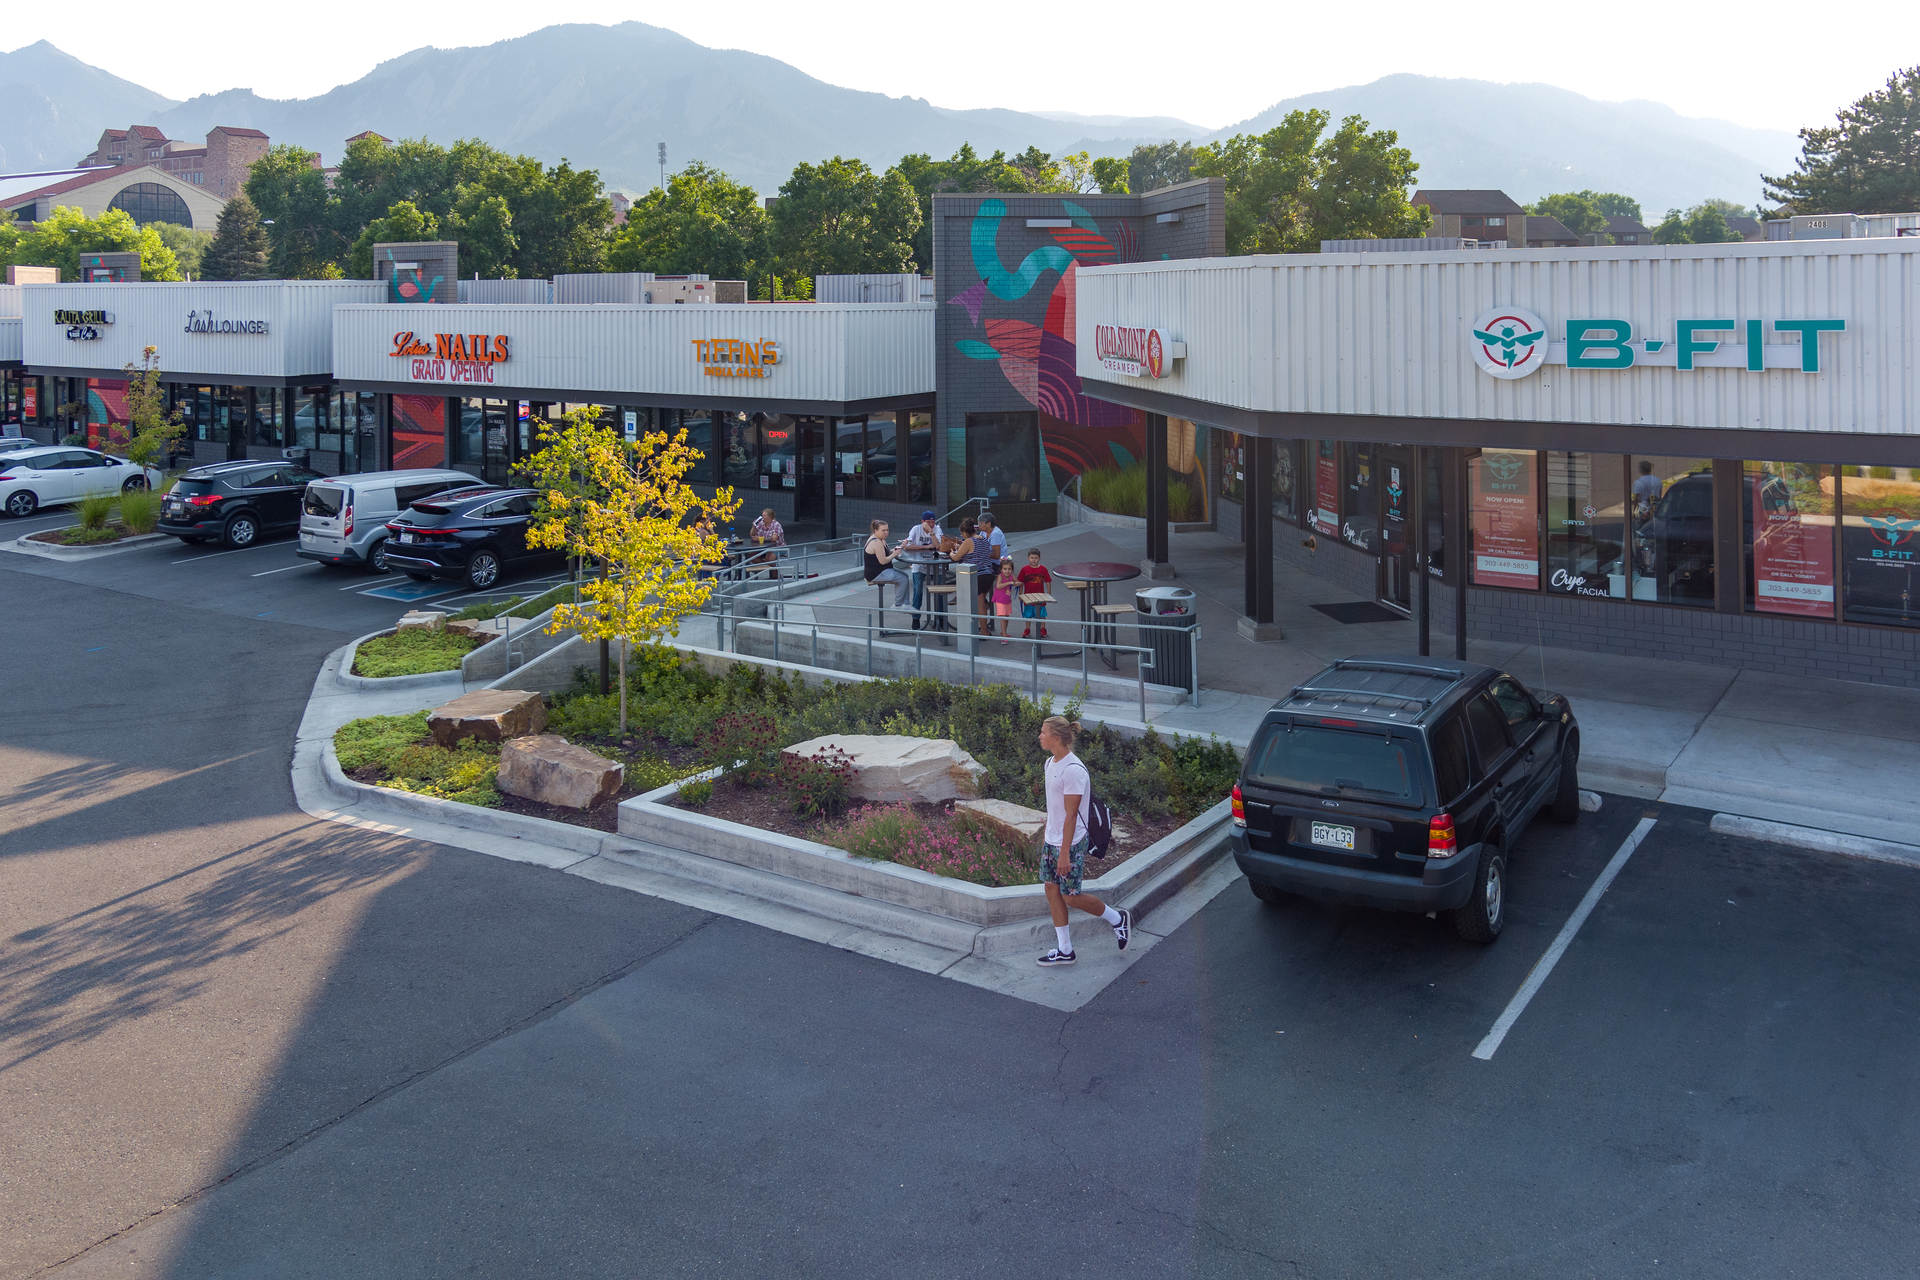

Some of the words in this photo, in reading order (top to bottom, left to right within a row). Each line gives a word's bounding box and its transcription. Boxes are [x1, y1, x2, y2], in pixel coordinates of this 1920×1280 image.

[1808, 220, 1827, 229] 2408
[82, 310, 105, 324] GRILL
[184, 309, 215, 333] Lash
[216, 320, 264, 334] LOUNGE
[389, 331, 431, 356] Lotus
[435, 333, 508, 362] NAILS
[691, 337, 777, 365] TIFFIN'S
[1096, 324, 1117, 361] COLD
[1117, 326, 1147, 367] STONE
[1566, 319, 1846, 373] B-FIT
[412, 359, 446, 380] GRAND
[450, 360, 493, 383] OPENING
[704, 367, 734, 377] INDIA
[736, 368, 764, 378] CAFE
[1104, 359, 1141, 375] CREAMERY
[768, 430, 788, 438] OPEN
[1872, 549, 1913, 559] B-FIT
[1484, 559, 1529, 570] 303-449-5855
[1551, 568, 1587, 591] Cryo
[1577, 587, 1610, 598] FACIAL
[1767, 584, 1822, 595] 303-449-5855
